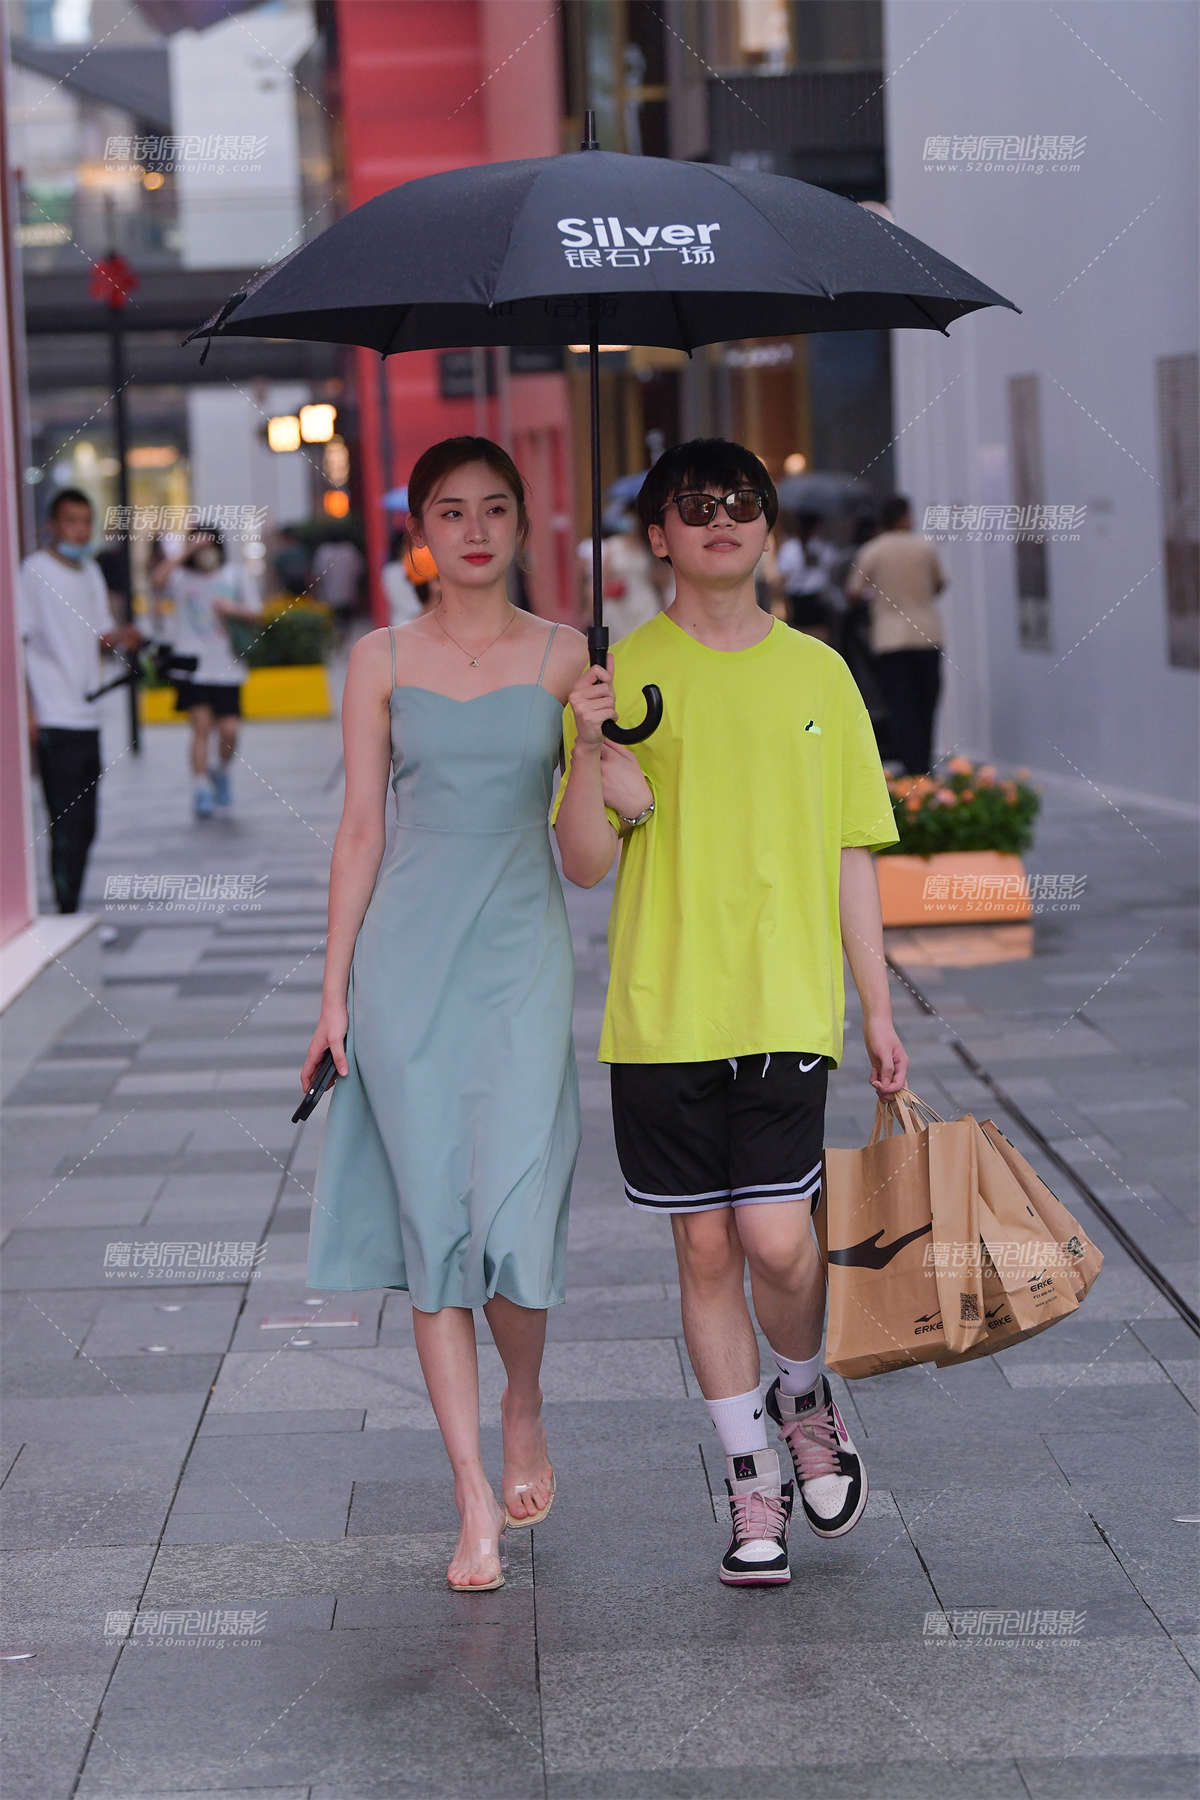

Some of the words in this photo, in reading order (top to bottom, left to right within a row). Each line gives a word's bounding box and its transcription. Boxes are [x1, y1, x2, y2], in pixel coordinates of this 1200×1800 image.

[557, 217, 721, 248] Silver
[564, 246, 716, 268] 银石广场
[1030, 1278, 1053, 1292] ERKE
[914, 1321, 944, 1335] ERKE
[988, 1314, 1012, 1330] ERKE
